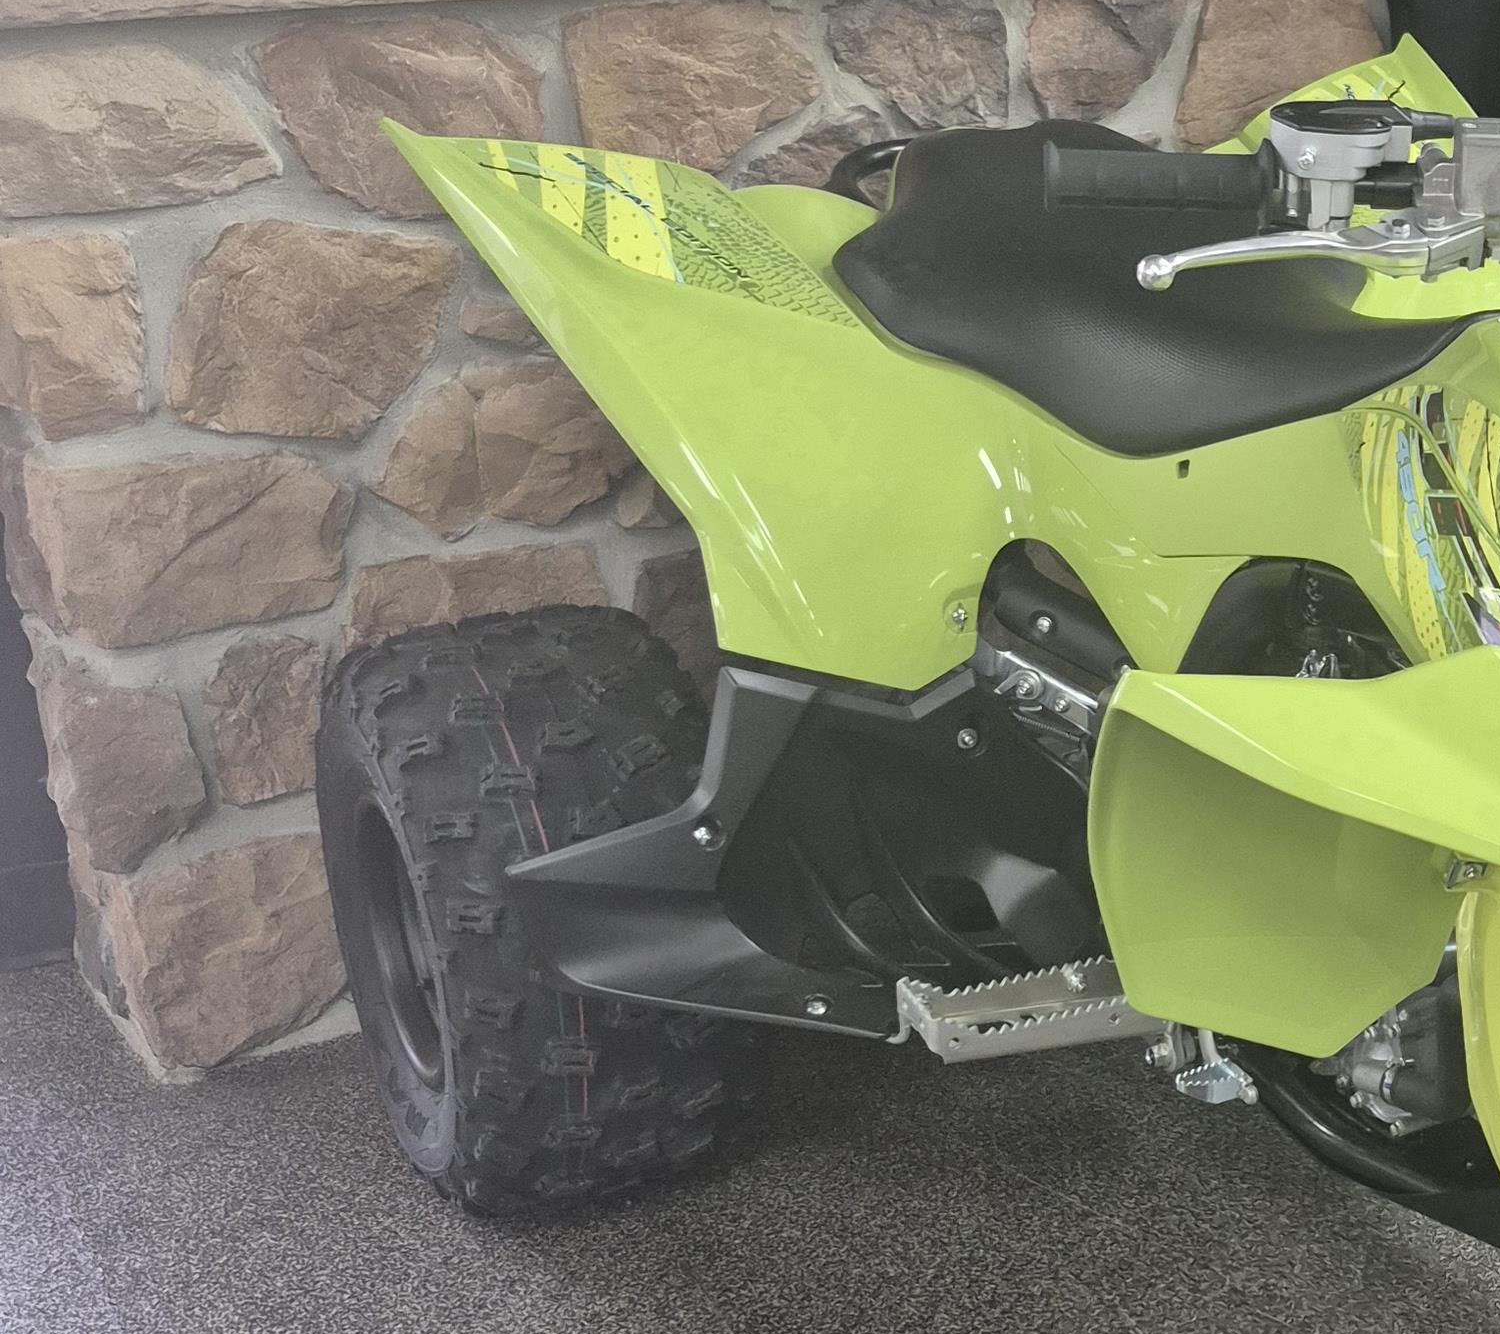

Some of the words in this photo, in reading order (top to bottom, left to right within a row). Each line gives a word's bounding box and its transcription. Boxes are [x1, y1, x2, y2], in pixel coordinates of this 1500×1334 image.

[563, 152, 656, 216] SPECIAL
[660, 217, 751, 281] EDITION
[1396, 428, 1447, 593] 450R
